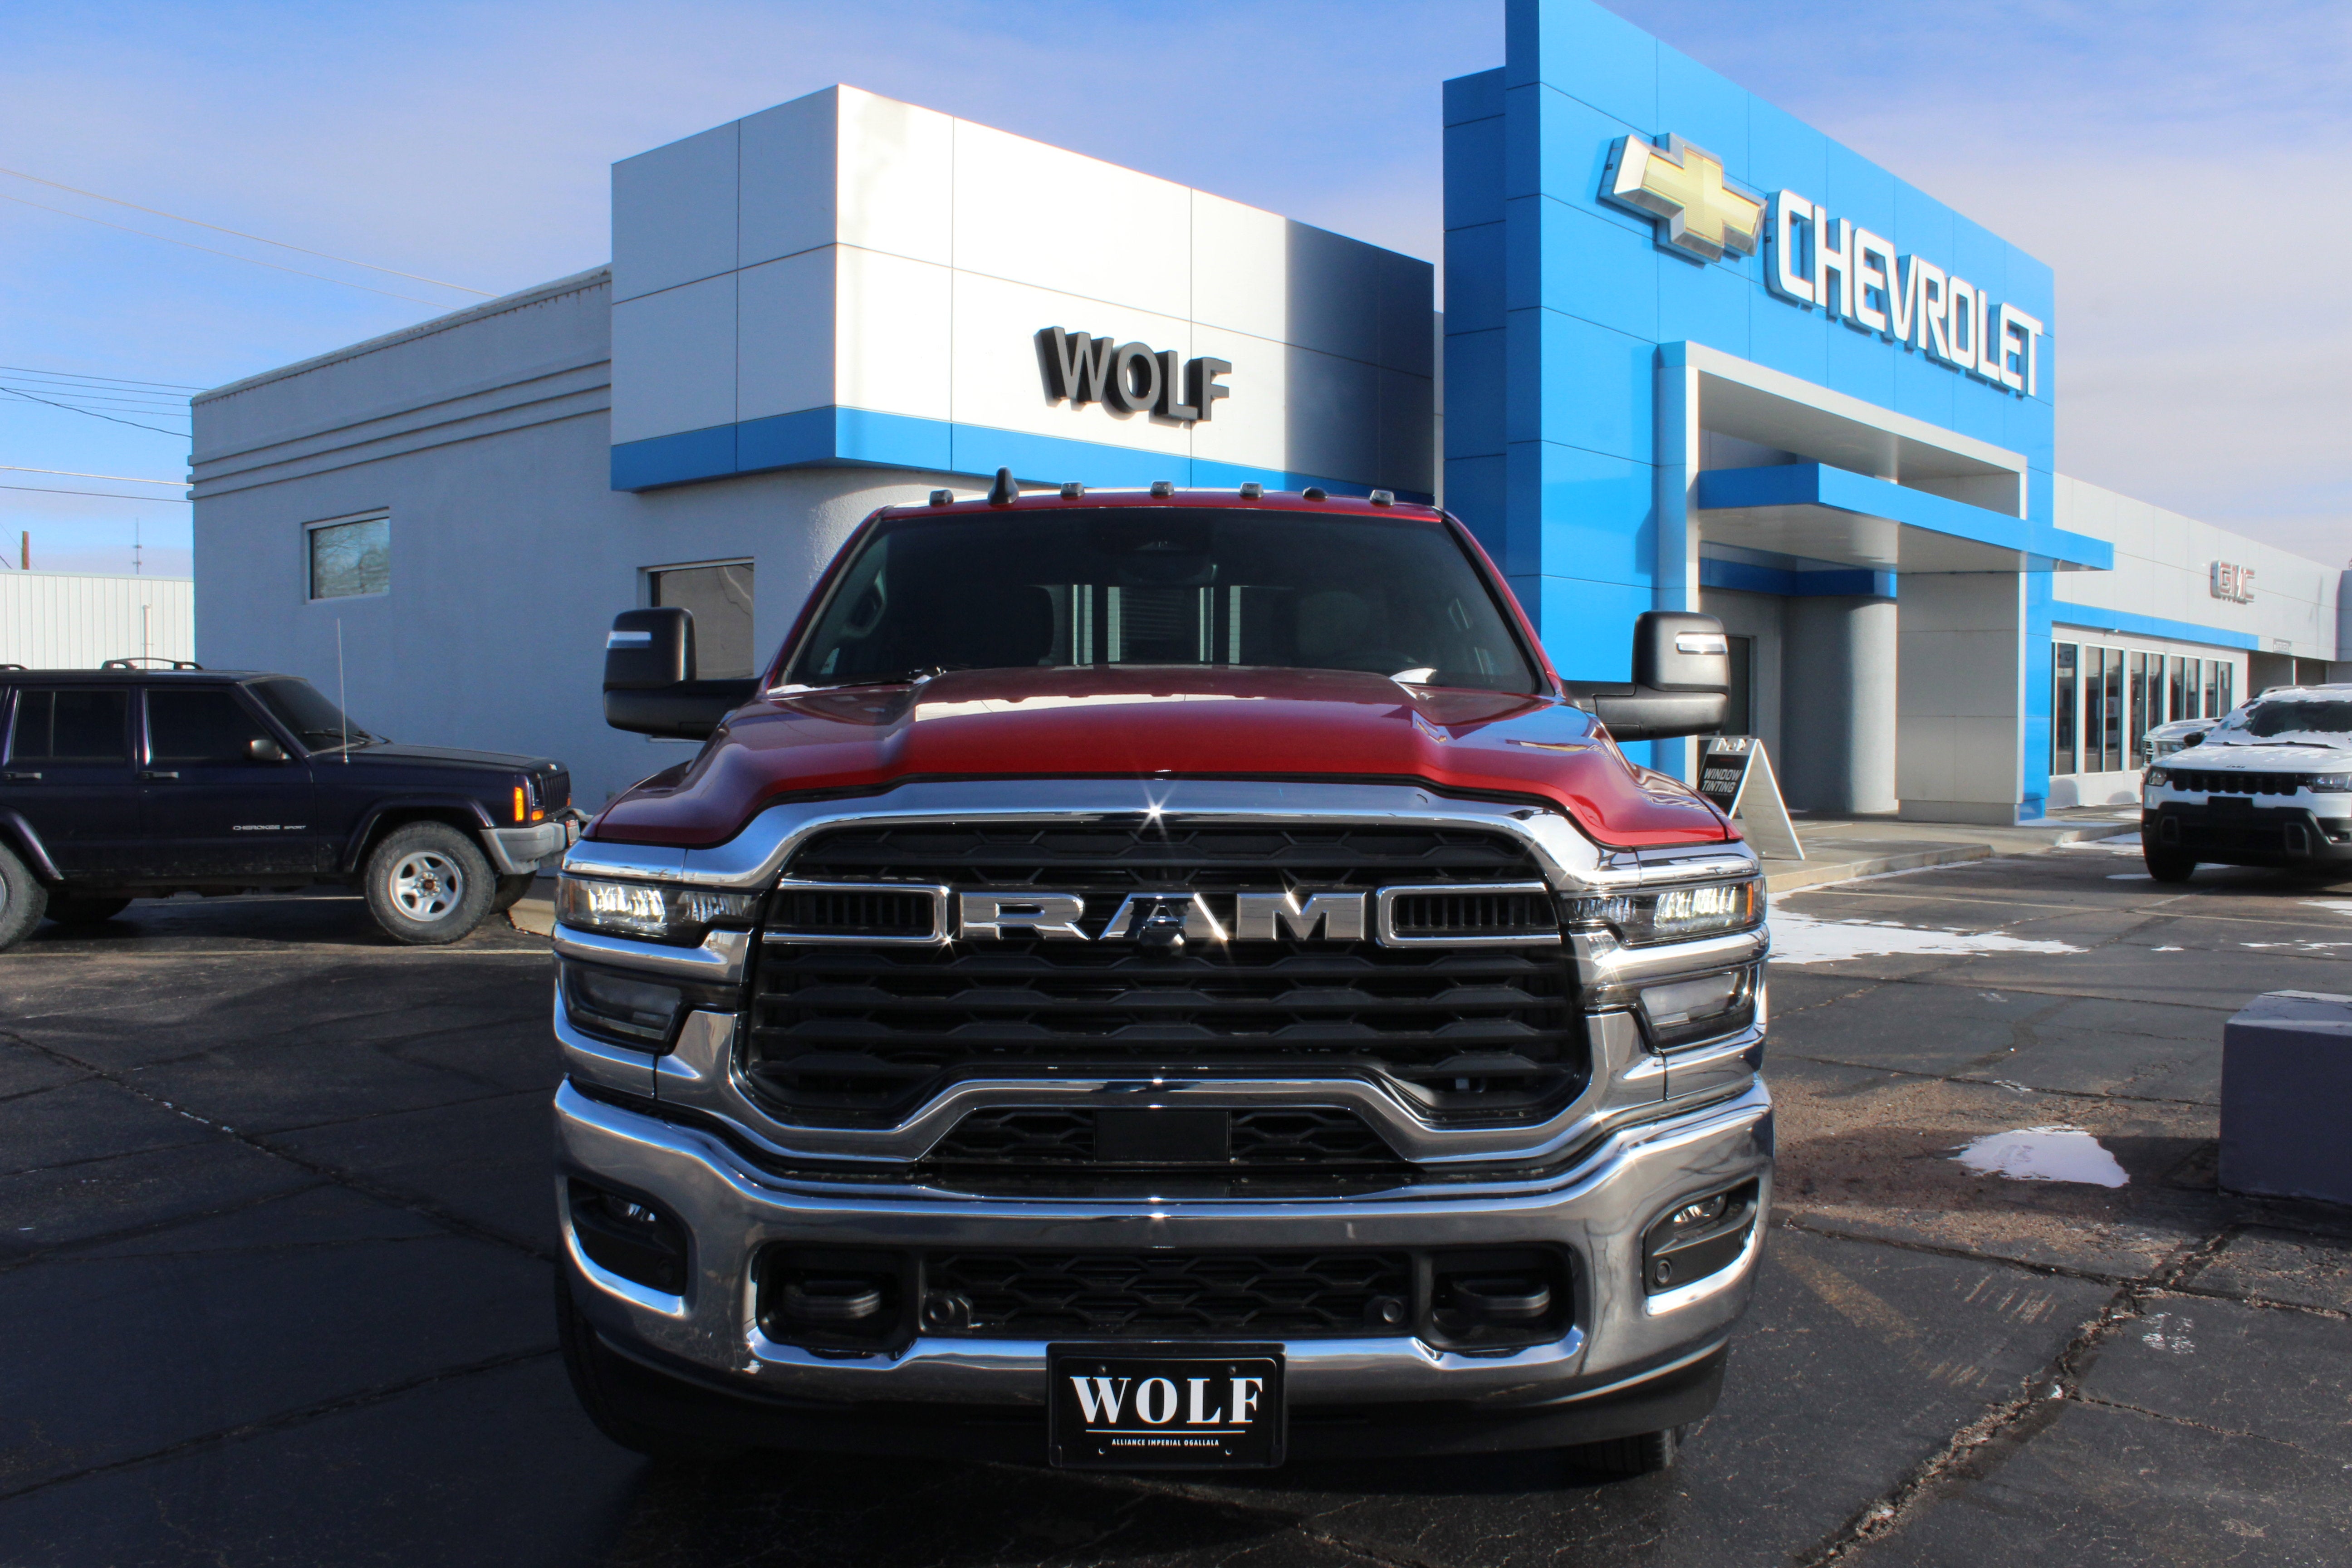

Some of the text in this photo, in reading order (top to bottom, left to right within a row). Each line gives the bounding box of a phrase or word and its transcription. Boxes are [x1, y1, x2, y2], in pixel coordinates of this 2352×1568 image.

[1764, 189, 2043, 398] CHEVROLET
[1034, 326, 1232, 423] WOLF
[1701, 780, 1736, 793] TINTING
[1704, 768, 1743, 781] WINDOW
[959, 892, 1367, 941] RAM
[1069, 1376, 1263, 1424] WOLF
[1112, 1438, 1220, 1447] ALLIANCE IMPERIAL OGALLALA
